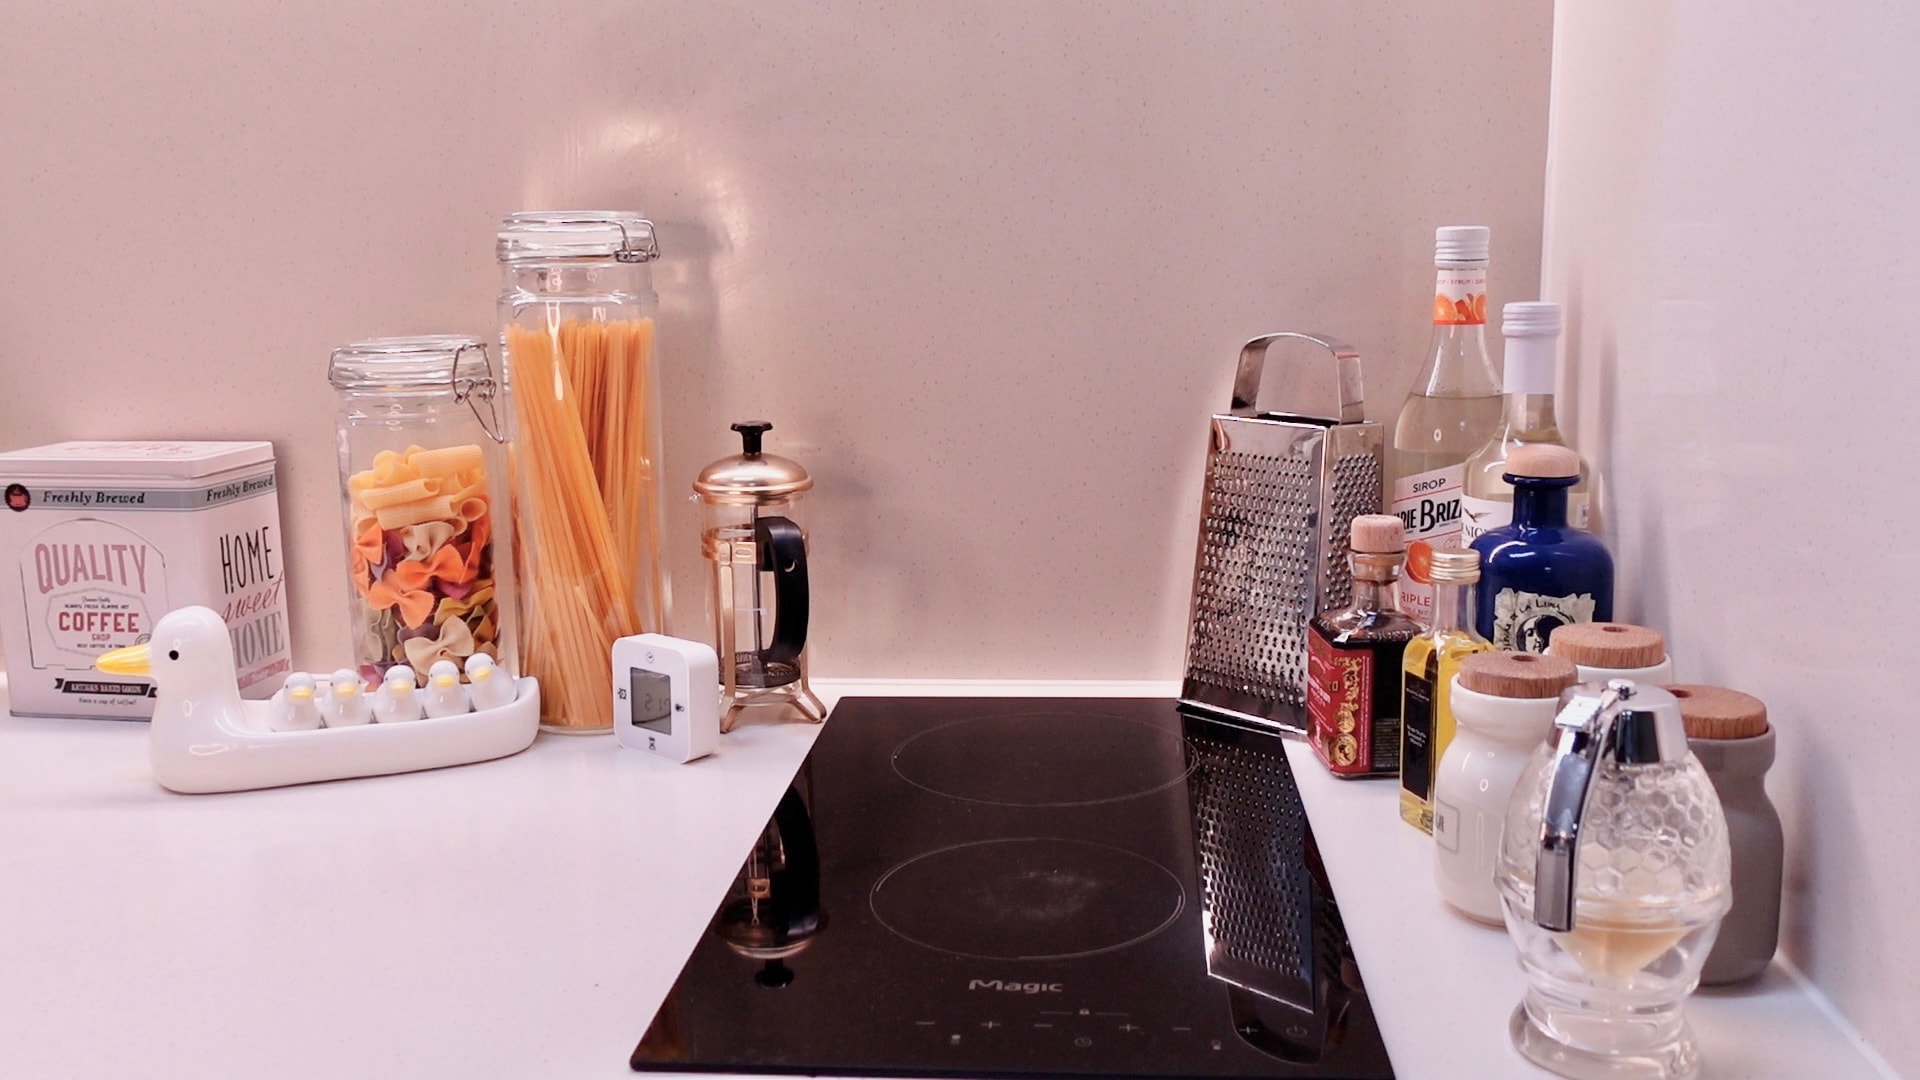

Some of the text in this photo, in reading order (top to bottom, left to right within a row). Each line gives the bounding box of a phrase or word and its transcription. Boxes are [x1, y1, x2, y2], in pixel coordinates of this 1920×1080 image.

[206, 475, 273, 502] Freshly Brewed
[1412, 478, 1446, 493] SIROP
[43, 491, 145, 505] Freshly Brewed
[1393, 508, 1416, 530] RIE
[34, 543, 147, 594] QUALITY
[220, 526, 274, 594] HOME
[221, 571, 284, 624] sweet
[1401, 592, 1431, 606] RIPLE
[59, 611, 139, 633] COFFEE
[91, 633, 111, 641] SHOP
